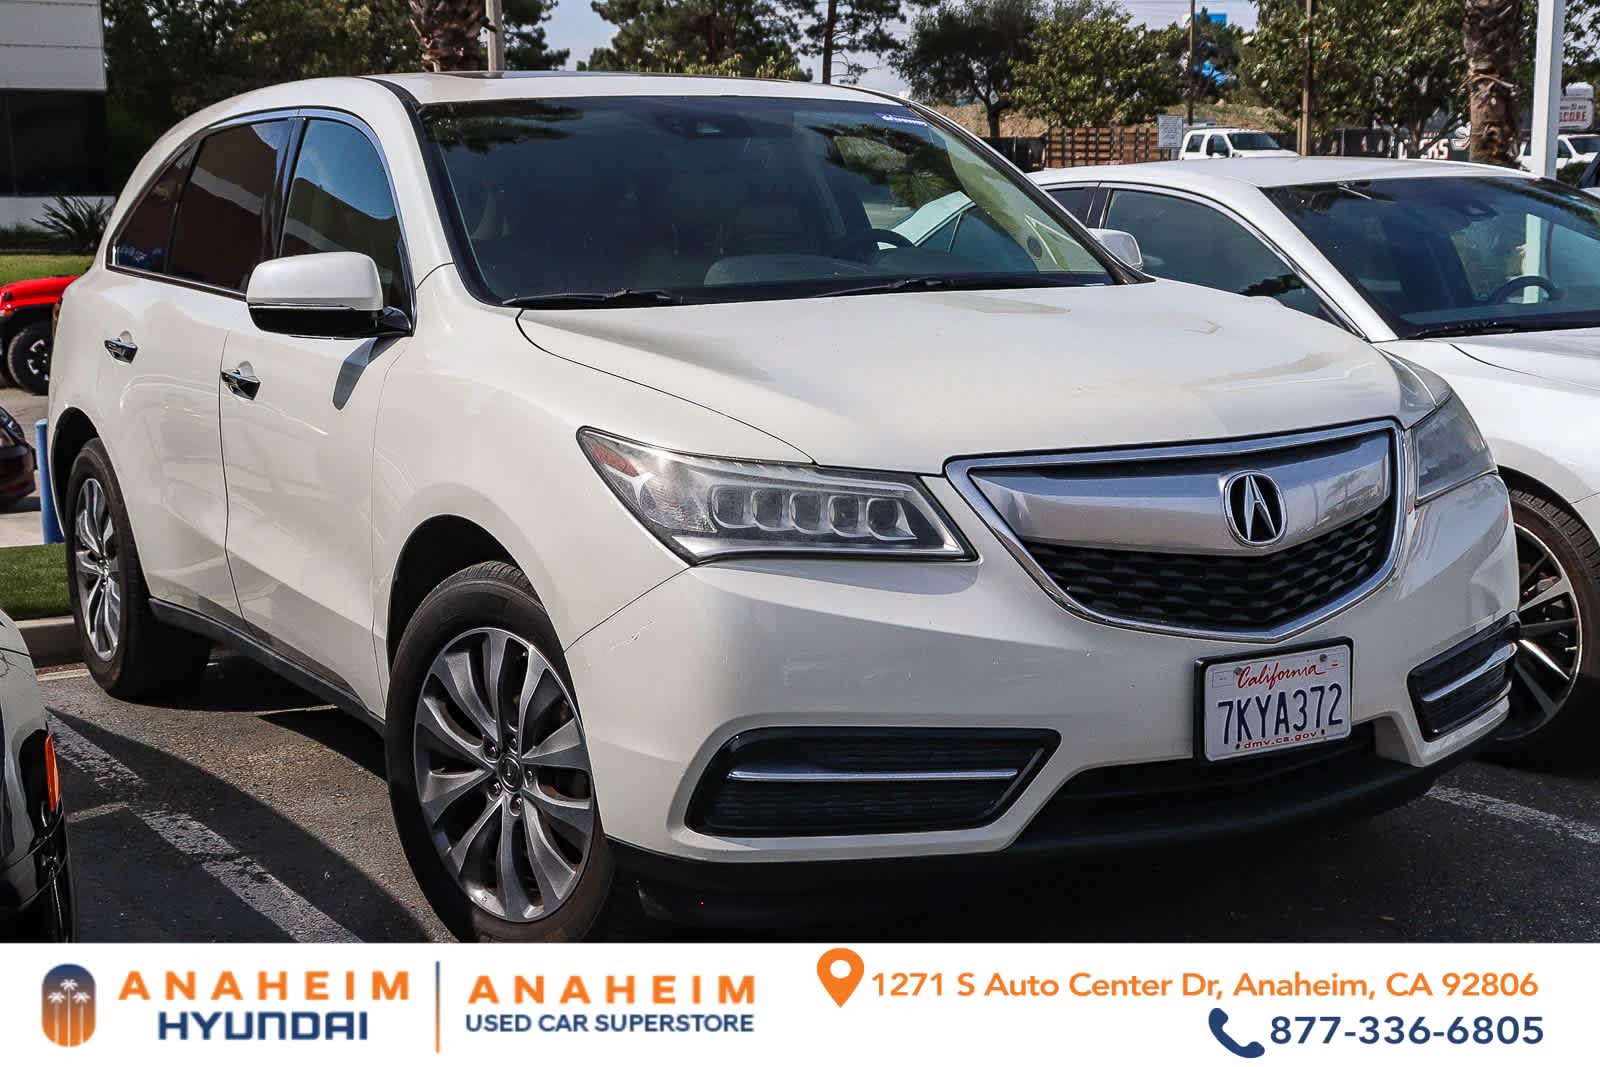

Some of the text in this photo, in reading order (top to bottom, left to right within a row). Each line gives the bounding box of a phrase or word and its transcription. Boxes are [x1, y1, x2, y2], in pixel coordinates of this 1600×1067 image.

[1237, 662, 1327, 690] California
[1217, 682, 1344, 745] 7KYA372
[1243, 731, 1317, 749] dmv.ca.gov
